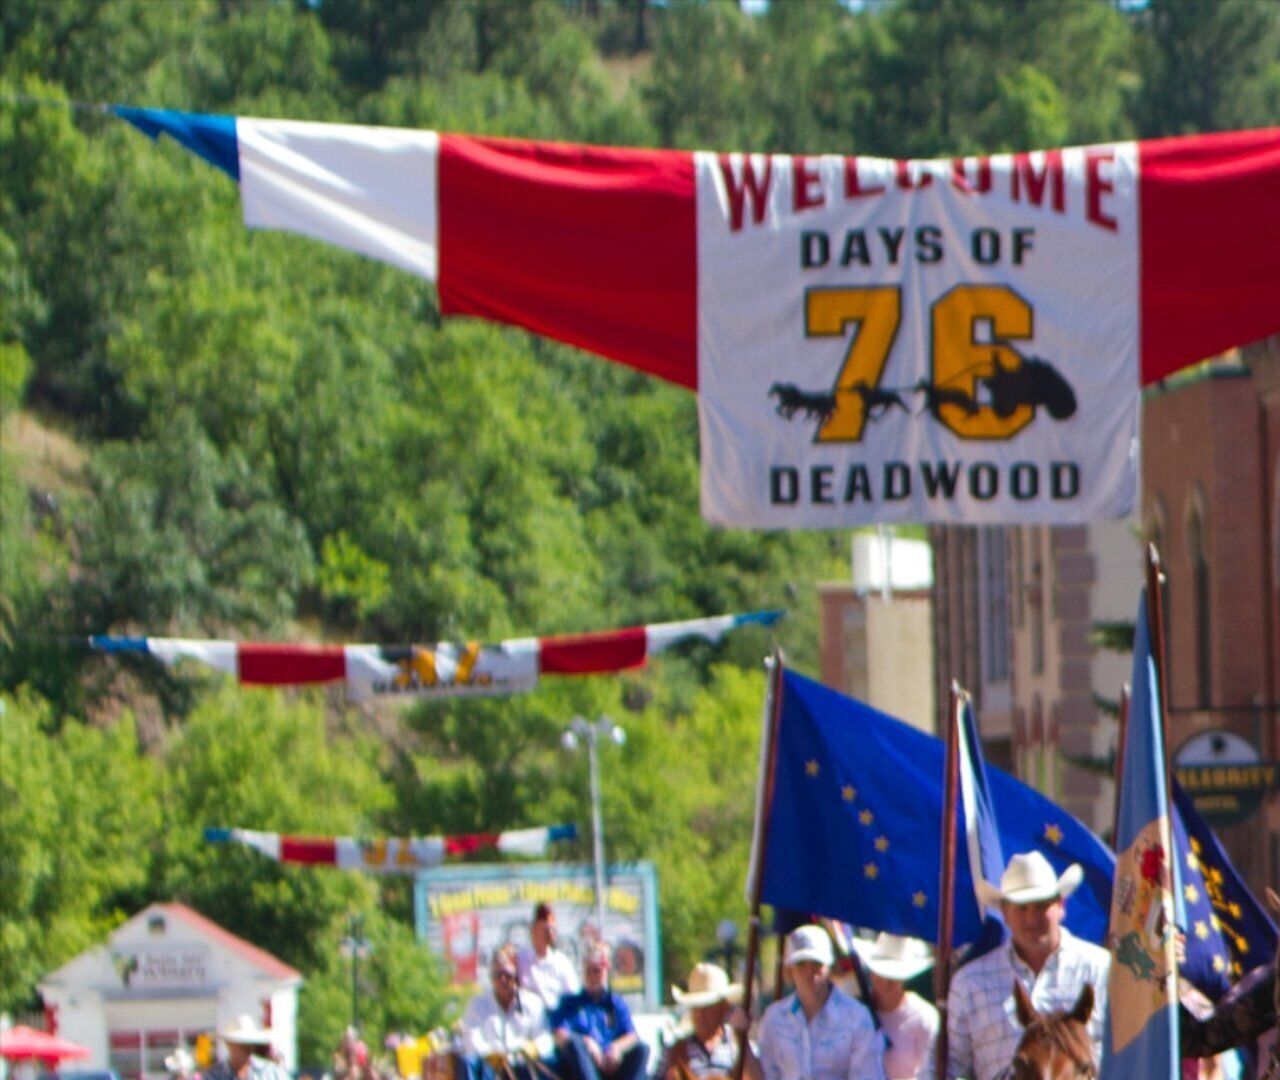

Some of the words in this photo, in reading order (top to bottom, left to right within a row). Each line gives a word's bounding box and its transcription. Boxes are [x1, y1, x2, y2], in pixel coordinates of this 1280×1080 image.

[717, 150, 1119, 233] WELCOME
[801, 227, 944, 268] DAYS
[971, 227, 1036, 266] OF
[804, 283, 1034, 444] 76
[769, 461, 1080, 506] DEADWOOD
[1176, 767, 1276, 788] ELEBRITY
